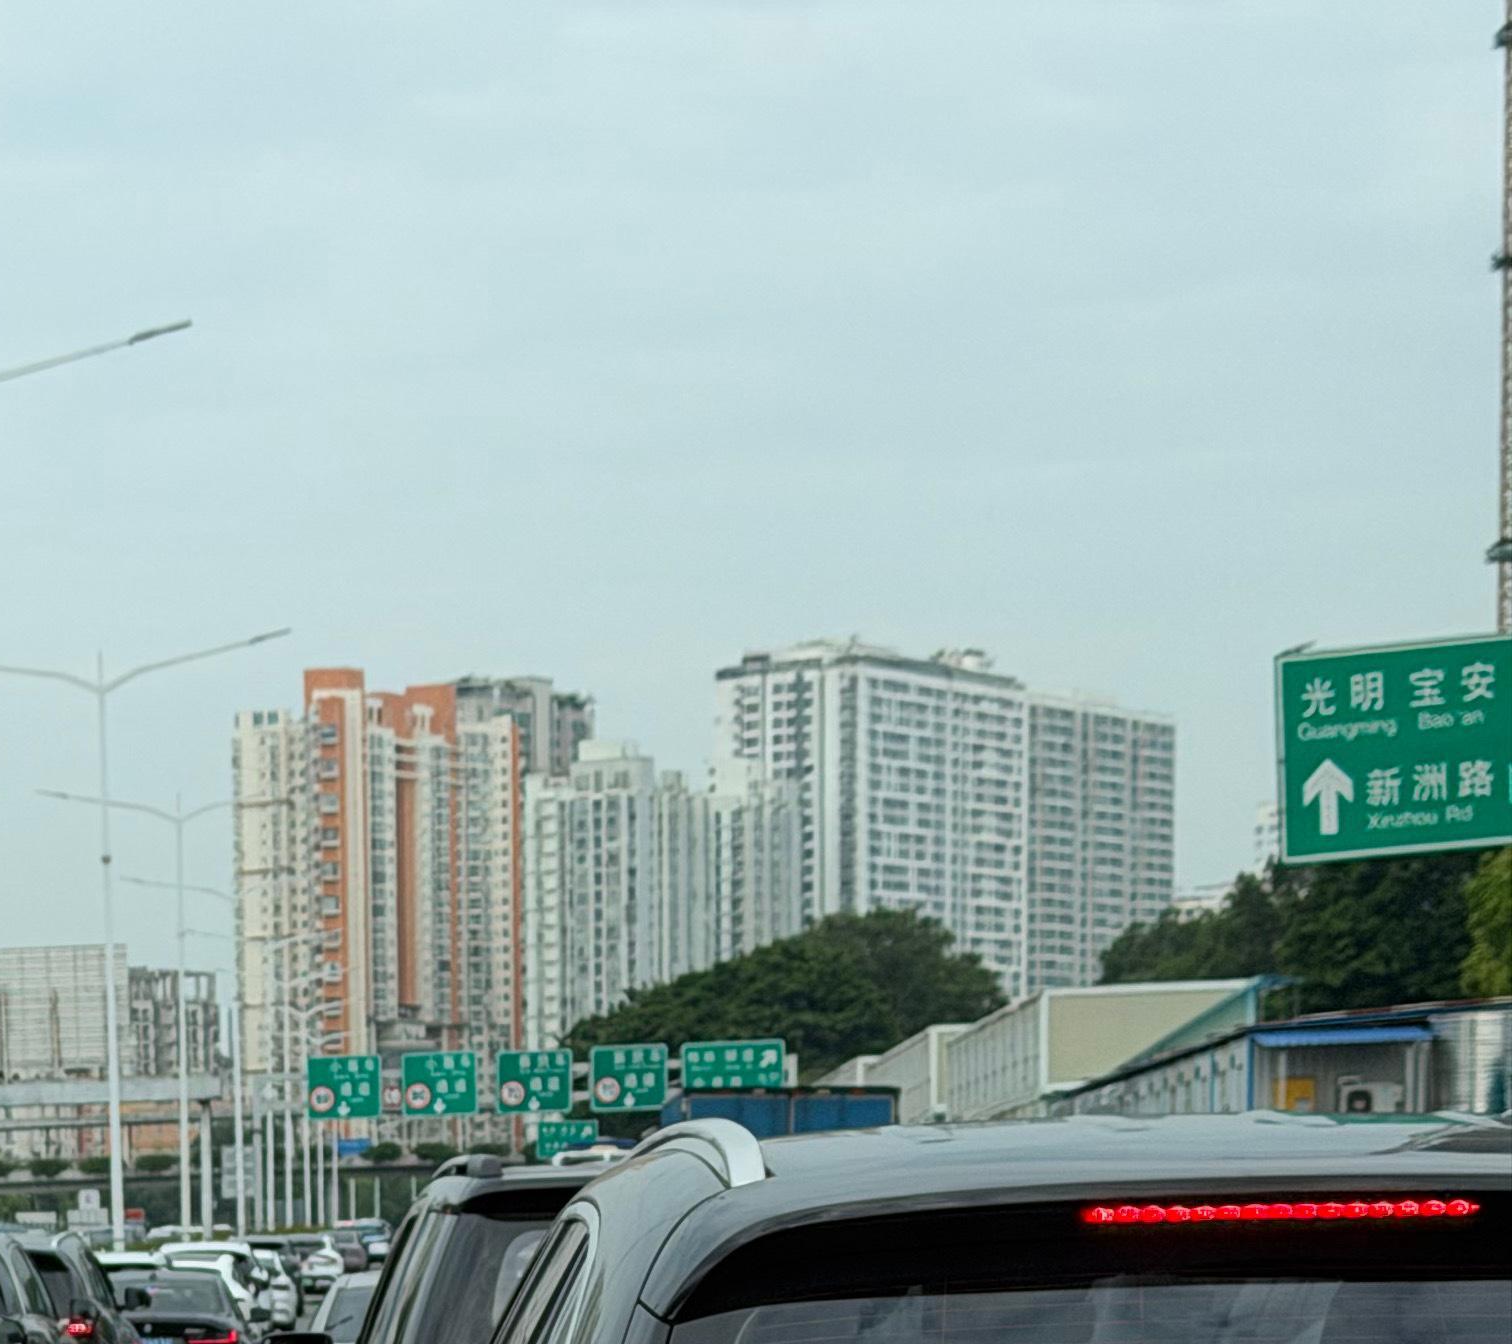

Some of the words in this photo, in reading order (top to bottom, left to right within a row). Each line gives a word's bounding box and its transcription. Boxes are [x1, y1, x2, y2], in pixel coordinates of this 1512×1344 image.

[1301, 670, 1385, 718] 光明
[1408, 661, 1496, 709] 宝安
[1366, 759, 1495, 807] 新洲路
[1445, 803, 1475, 823] Rd
